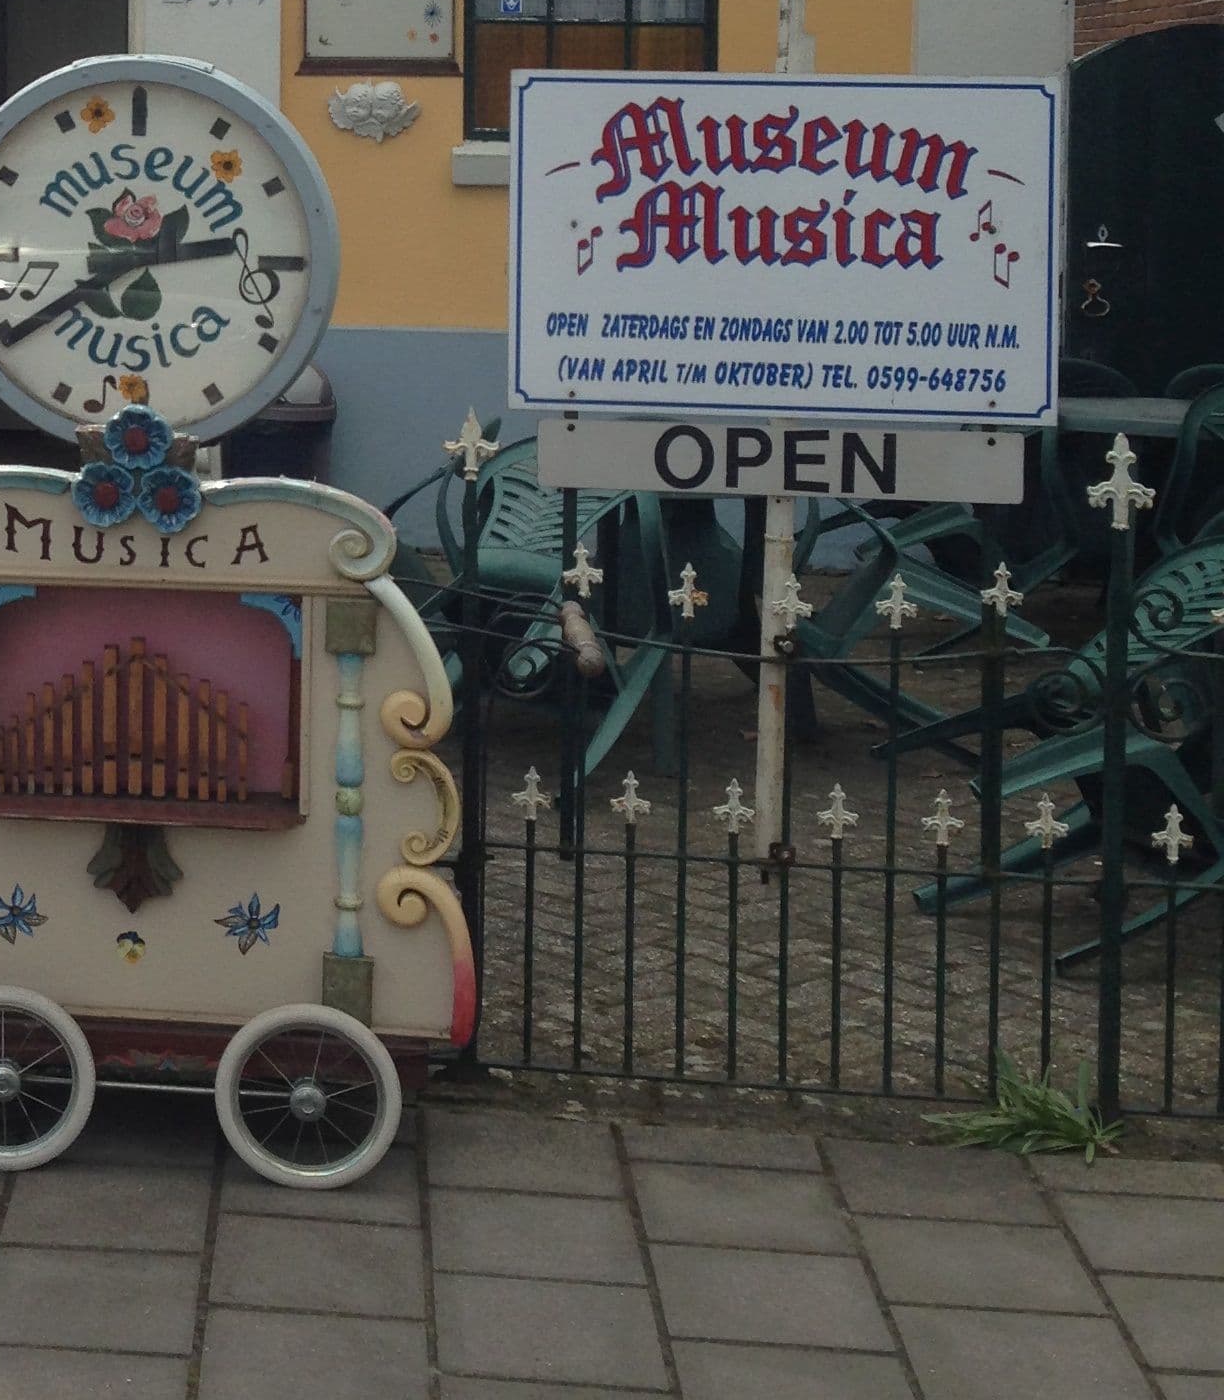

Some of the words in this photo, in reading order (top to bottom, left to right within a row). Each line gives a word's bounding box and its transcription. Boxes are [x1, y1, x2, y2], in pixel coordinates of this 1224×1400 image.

[590, 96, 979, 203] Museum
[39, 143, 244, 234] museum
[616, 180, 944, 272] Musica
[546, 313, 588, 337] OPEN
[601, 313, 690, 342] ZATERDAGS
[694, 315, 714, 341] EN
[719, 316, 793, 345] ZONDAGS
[798, 318, 829, 344] VAN
[834, 319, 868, 346] 2.00
[874, 320, 903, 345] TOT
[906, 320, 942, 348] 5.00
[947, 322, 980, 348] UUR
[985, 324, 1020, 349] N.M.
[557, 355, 605, 383] (VAN
[612, 358, 668, 384] APRIL
[676, 363, 706, 384] T/M
[715, 361, 813, 390] OKTOBER)
[822, 364, 858, 389] TEL.
[866, 365, 1007, 393] 0599-648756
[653, 424, 898, 494] OPEN
[4, 502, 271, 569] MUSICA
